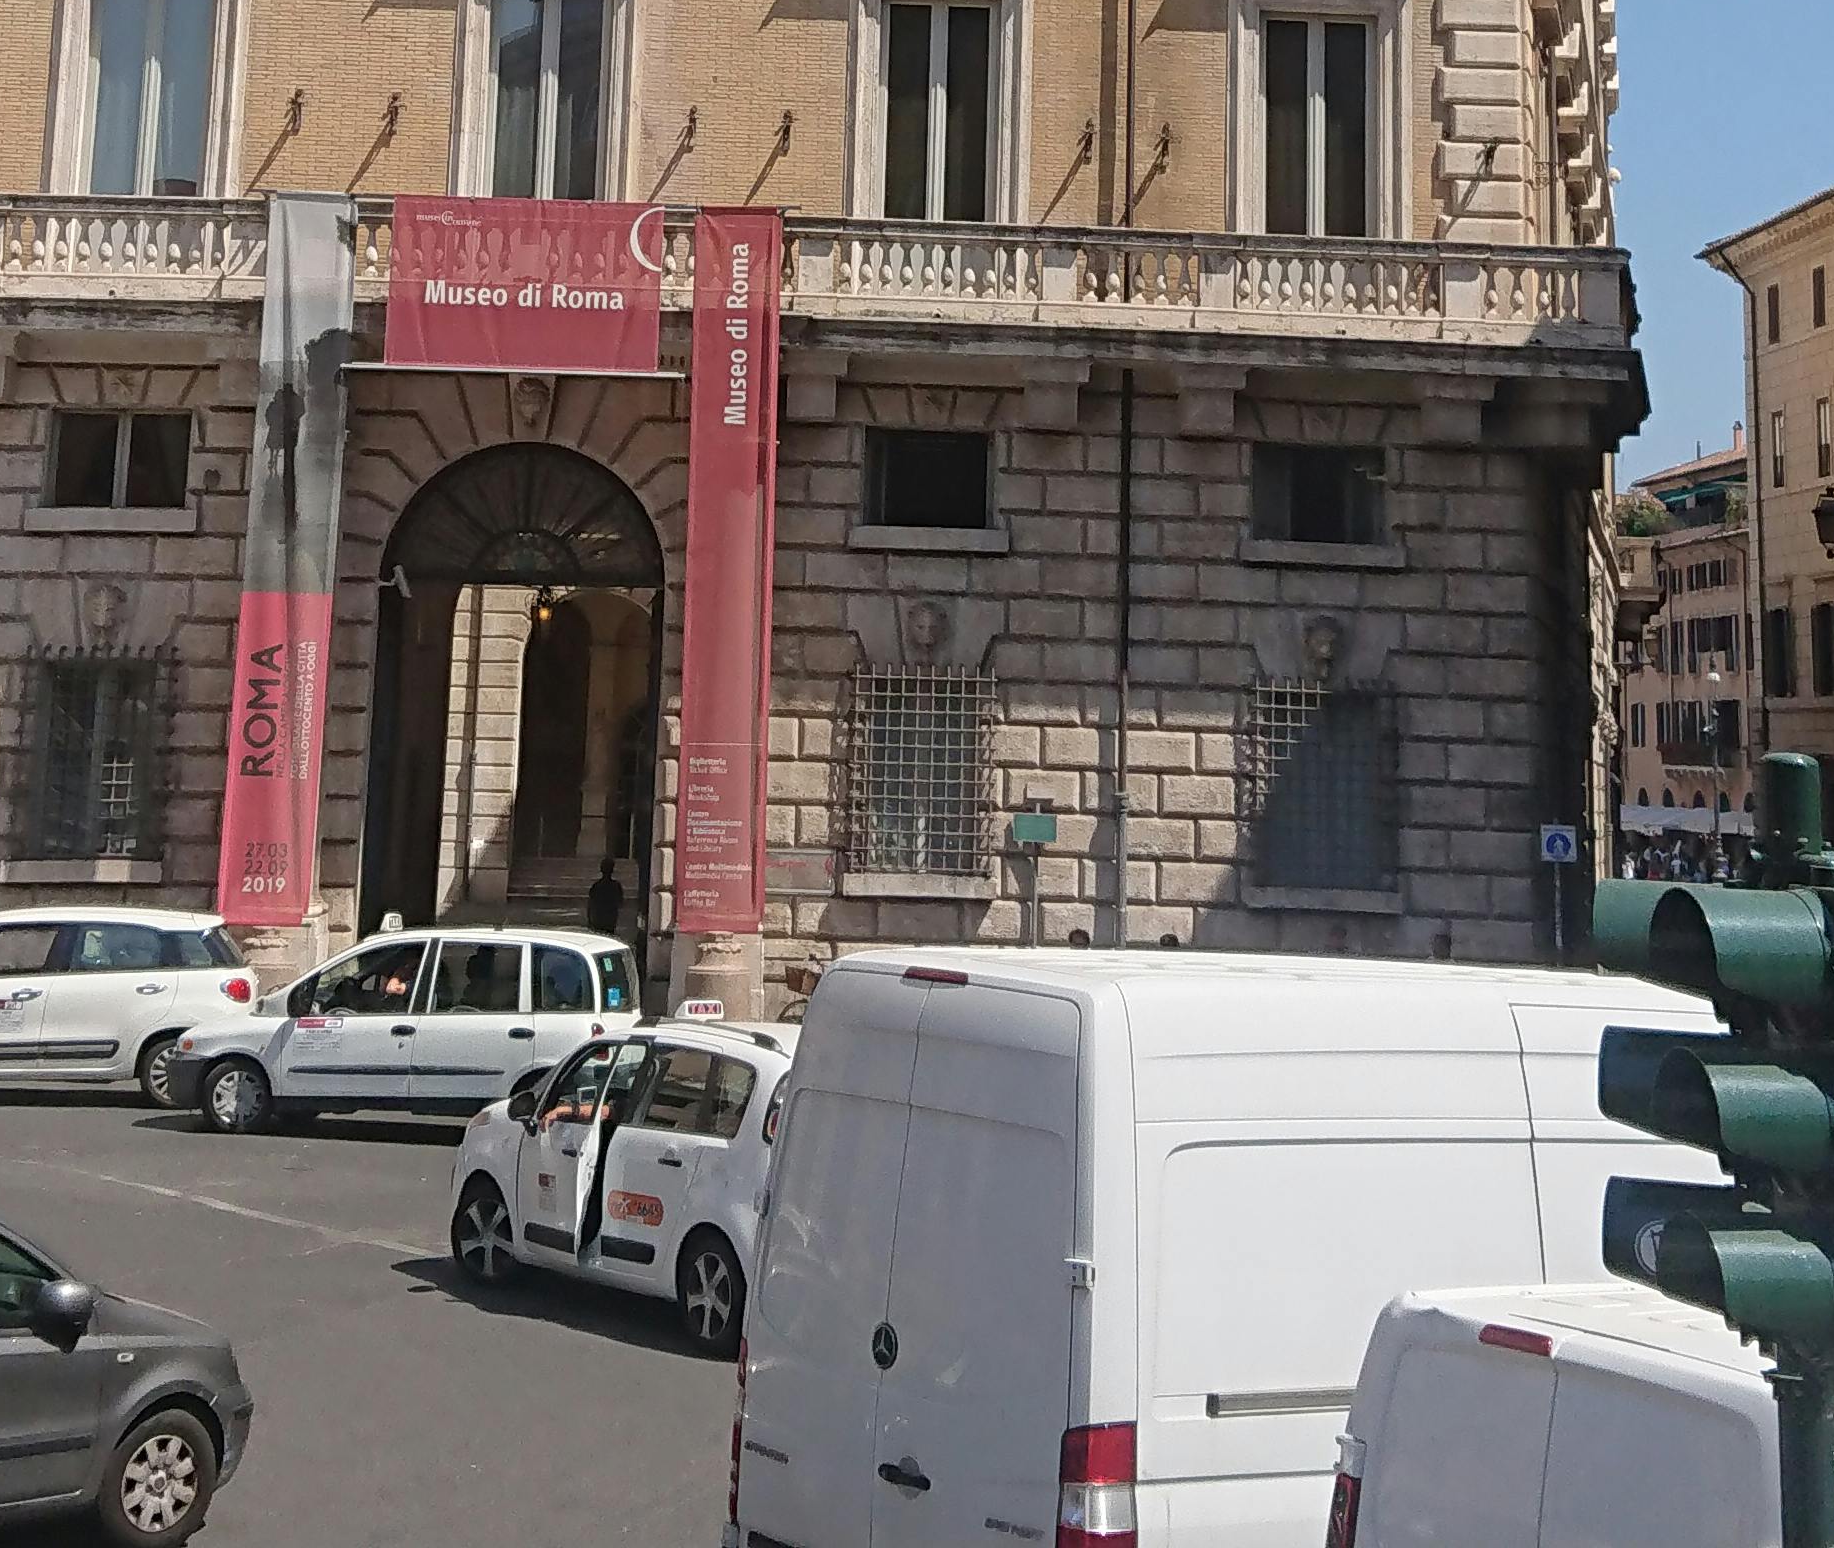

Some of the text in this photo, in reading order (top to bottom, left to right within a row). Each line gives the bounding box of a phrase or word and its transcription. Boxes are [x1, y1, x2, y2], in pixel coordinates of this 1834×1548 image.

[424, 280, 624, 310] Museo di Roma
[723, 243, 749, 426] Museo di Roma
[307, 641, 317, 670] OGGI
[240, 643, 283, 777] ROMA
[245, 860, 289, 875] 22.09
[241, 876, 286, 894] 2019
[688, 1002, 721, 1015] TAXI
